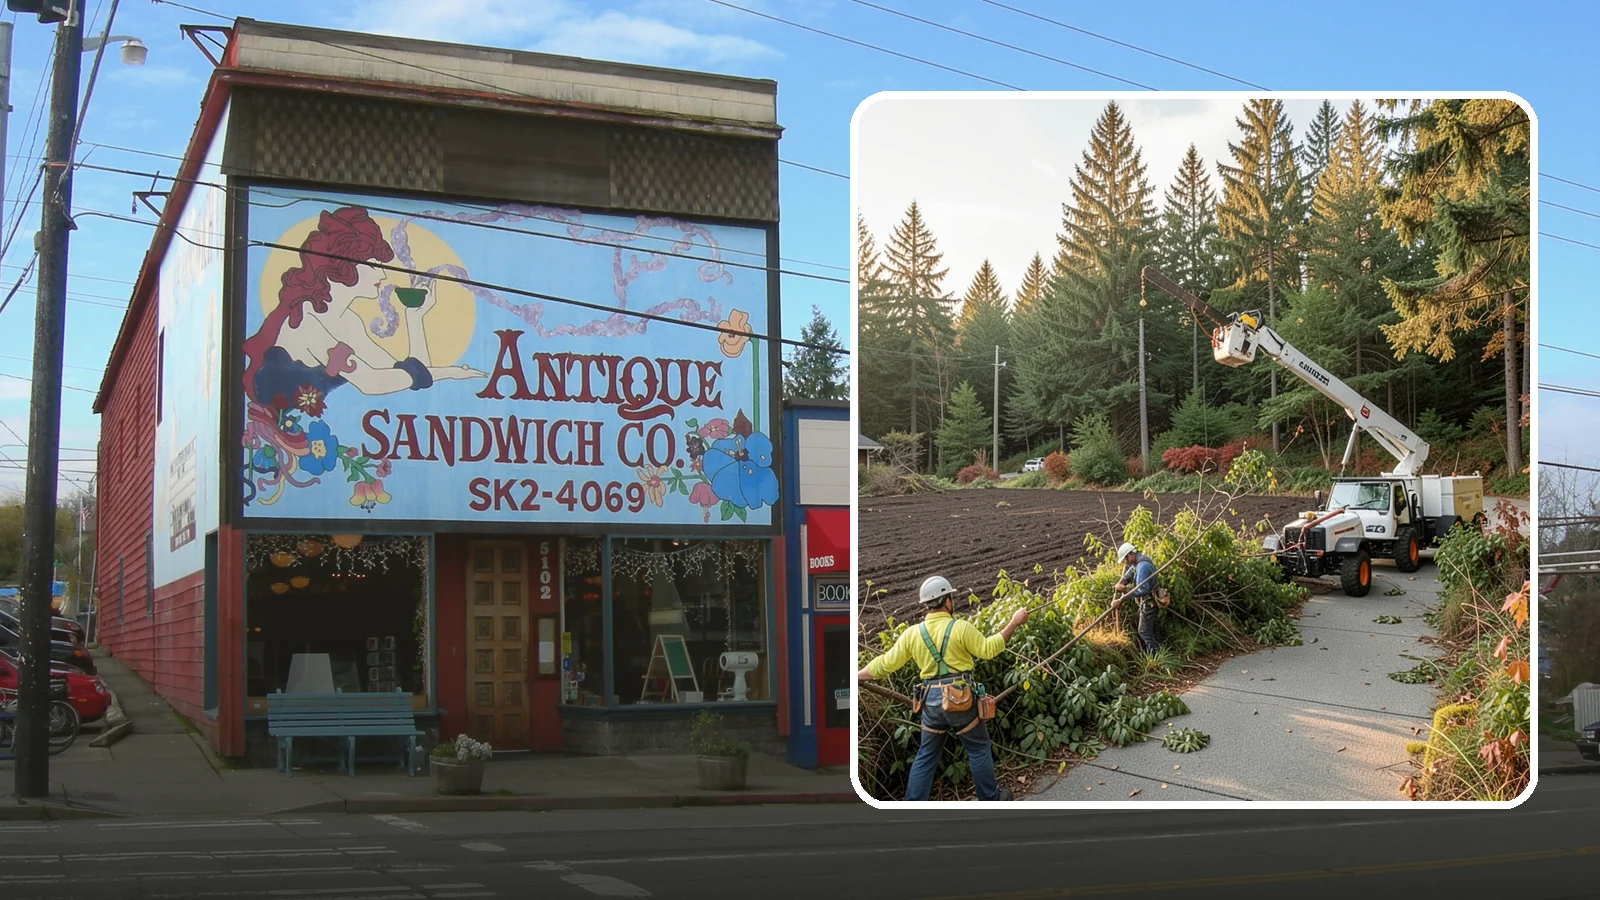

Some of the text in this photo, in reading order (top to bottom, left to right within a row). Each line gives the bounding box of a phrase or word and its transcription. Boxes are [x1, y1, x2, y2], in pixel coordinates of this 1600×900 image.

[475, 329, 724, 420] ANTIQUE
[361, 408, 685, 469] SANDWICH CO.
[468, 477, 646, 513] SK2-4069
[539, 541, 552, 600] 5102
[809, 555, 835, 569] BOOKS
